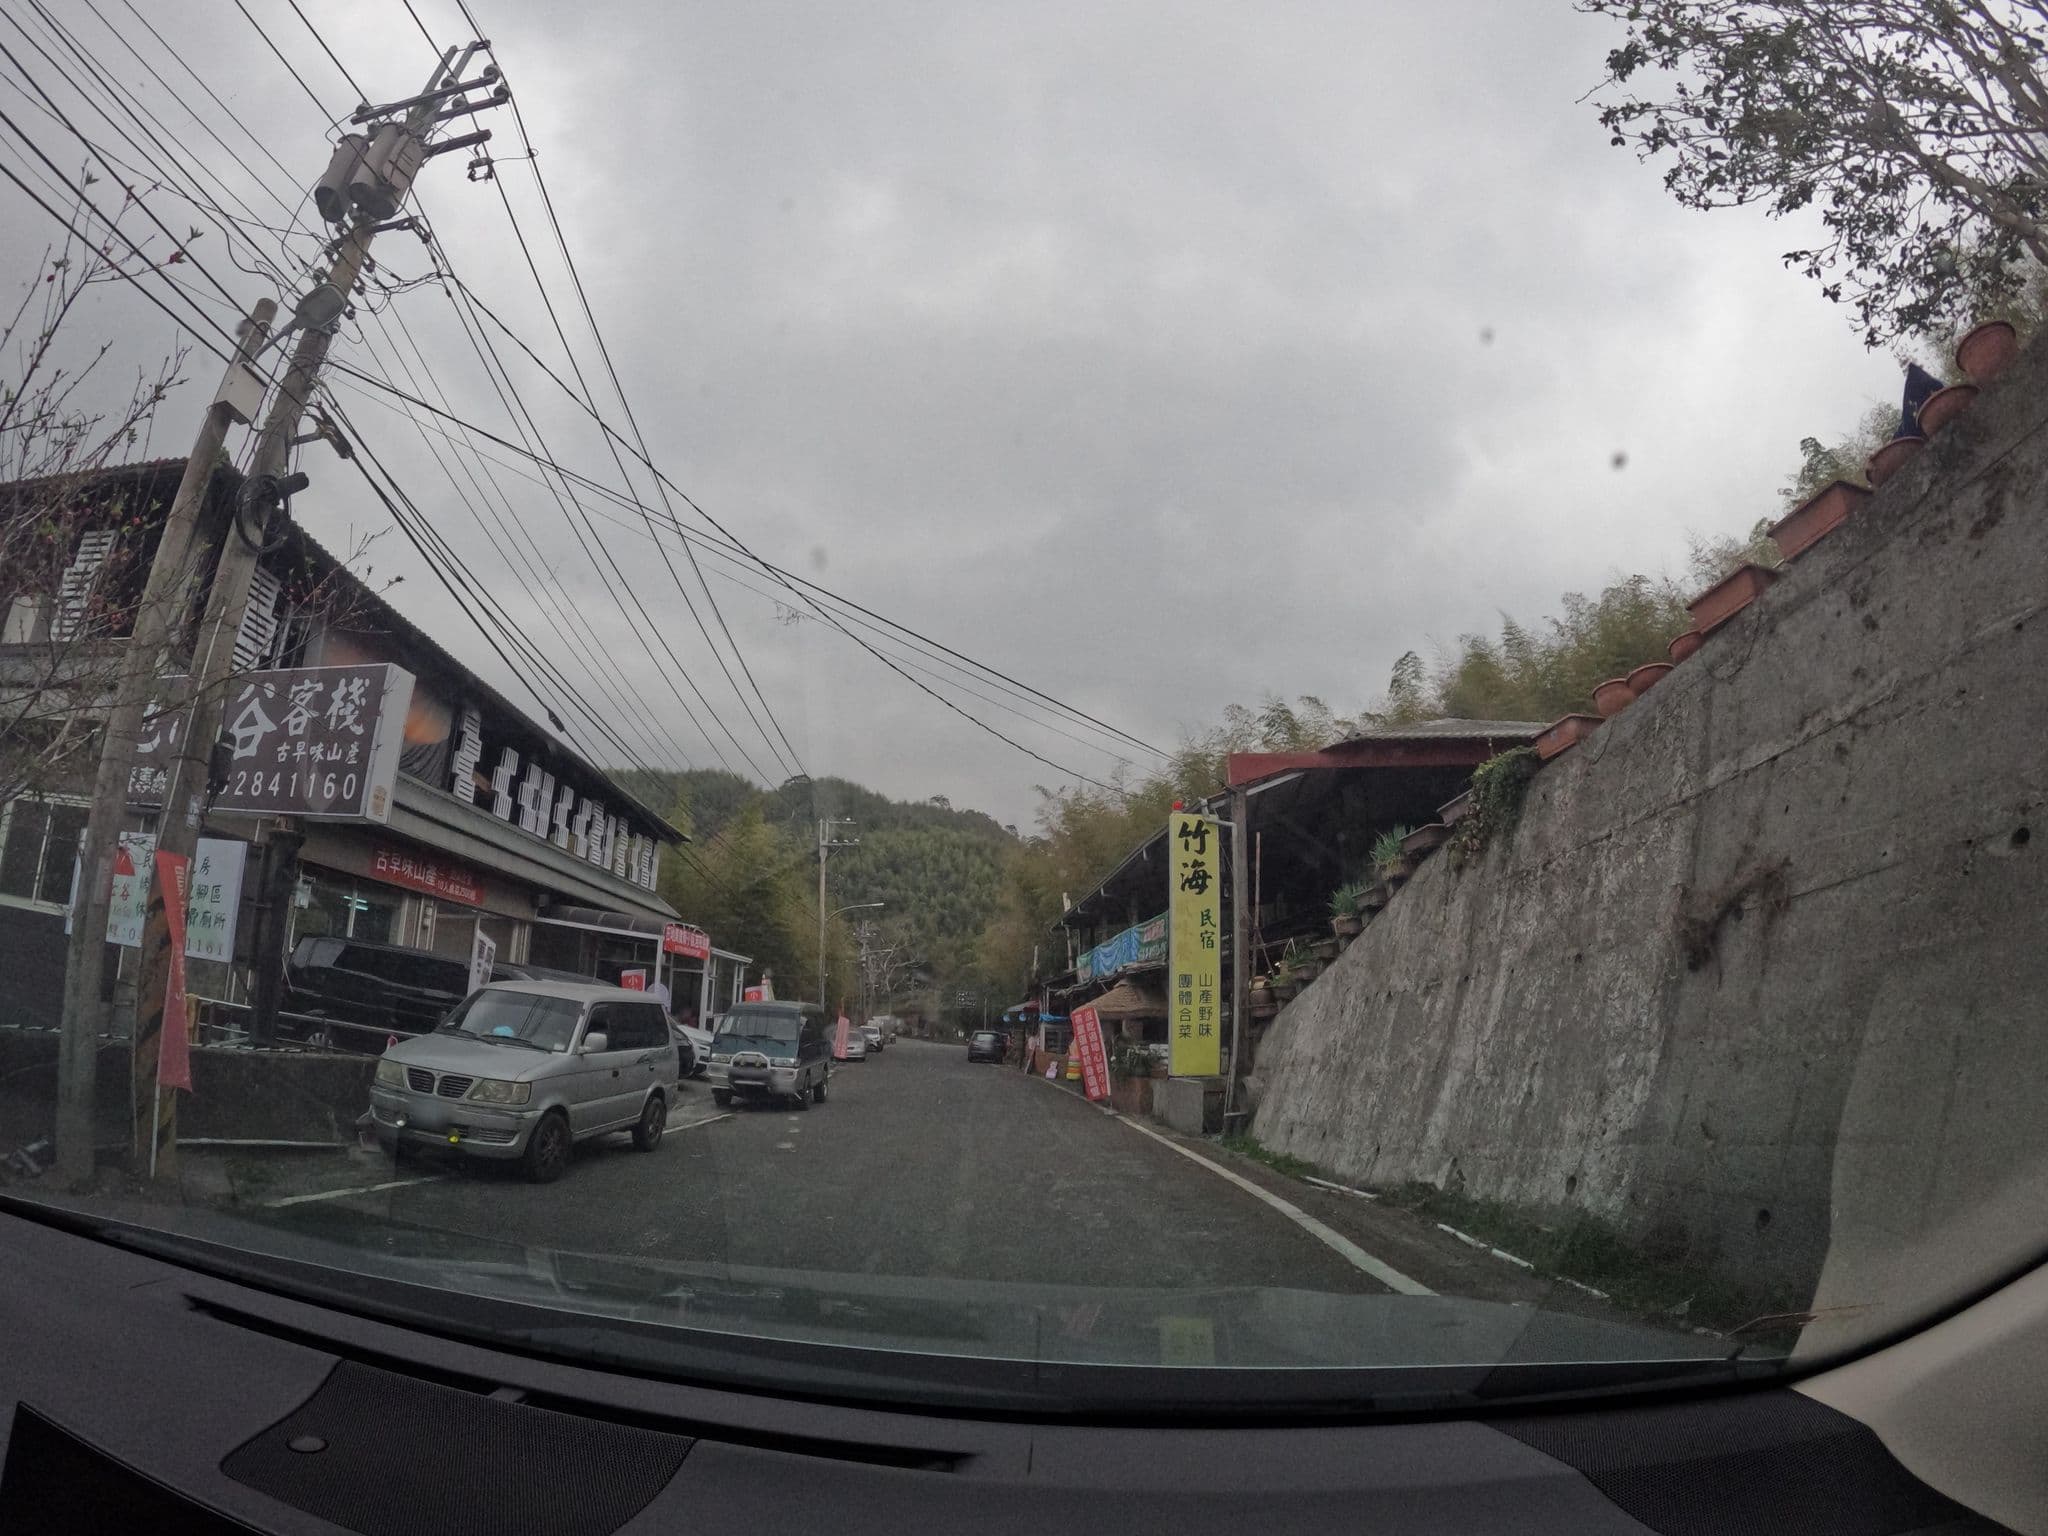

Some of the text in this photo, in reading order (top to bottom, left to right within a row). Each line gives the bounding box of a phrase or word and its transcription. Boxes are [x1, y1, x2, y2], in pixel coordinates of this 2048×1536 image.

[277, 741, 360, 765] 古早味山產
[376, 850, 437, 886] 古早味山產
[1177, 818, 1213, 896] 竹海
[1199, 908, 1217, 951] 民宿
[1178, 973, 1193, 1040] 團體合菜
[1198, 973, 1214, 1039] 山產野味
